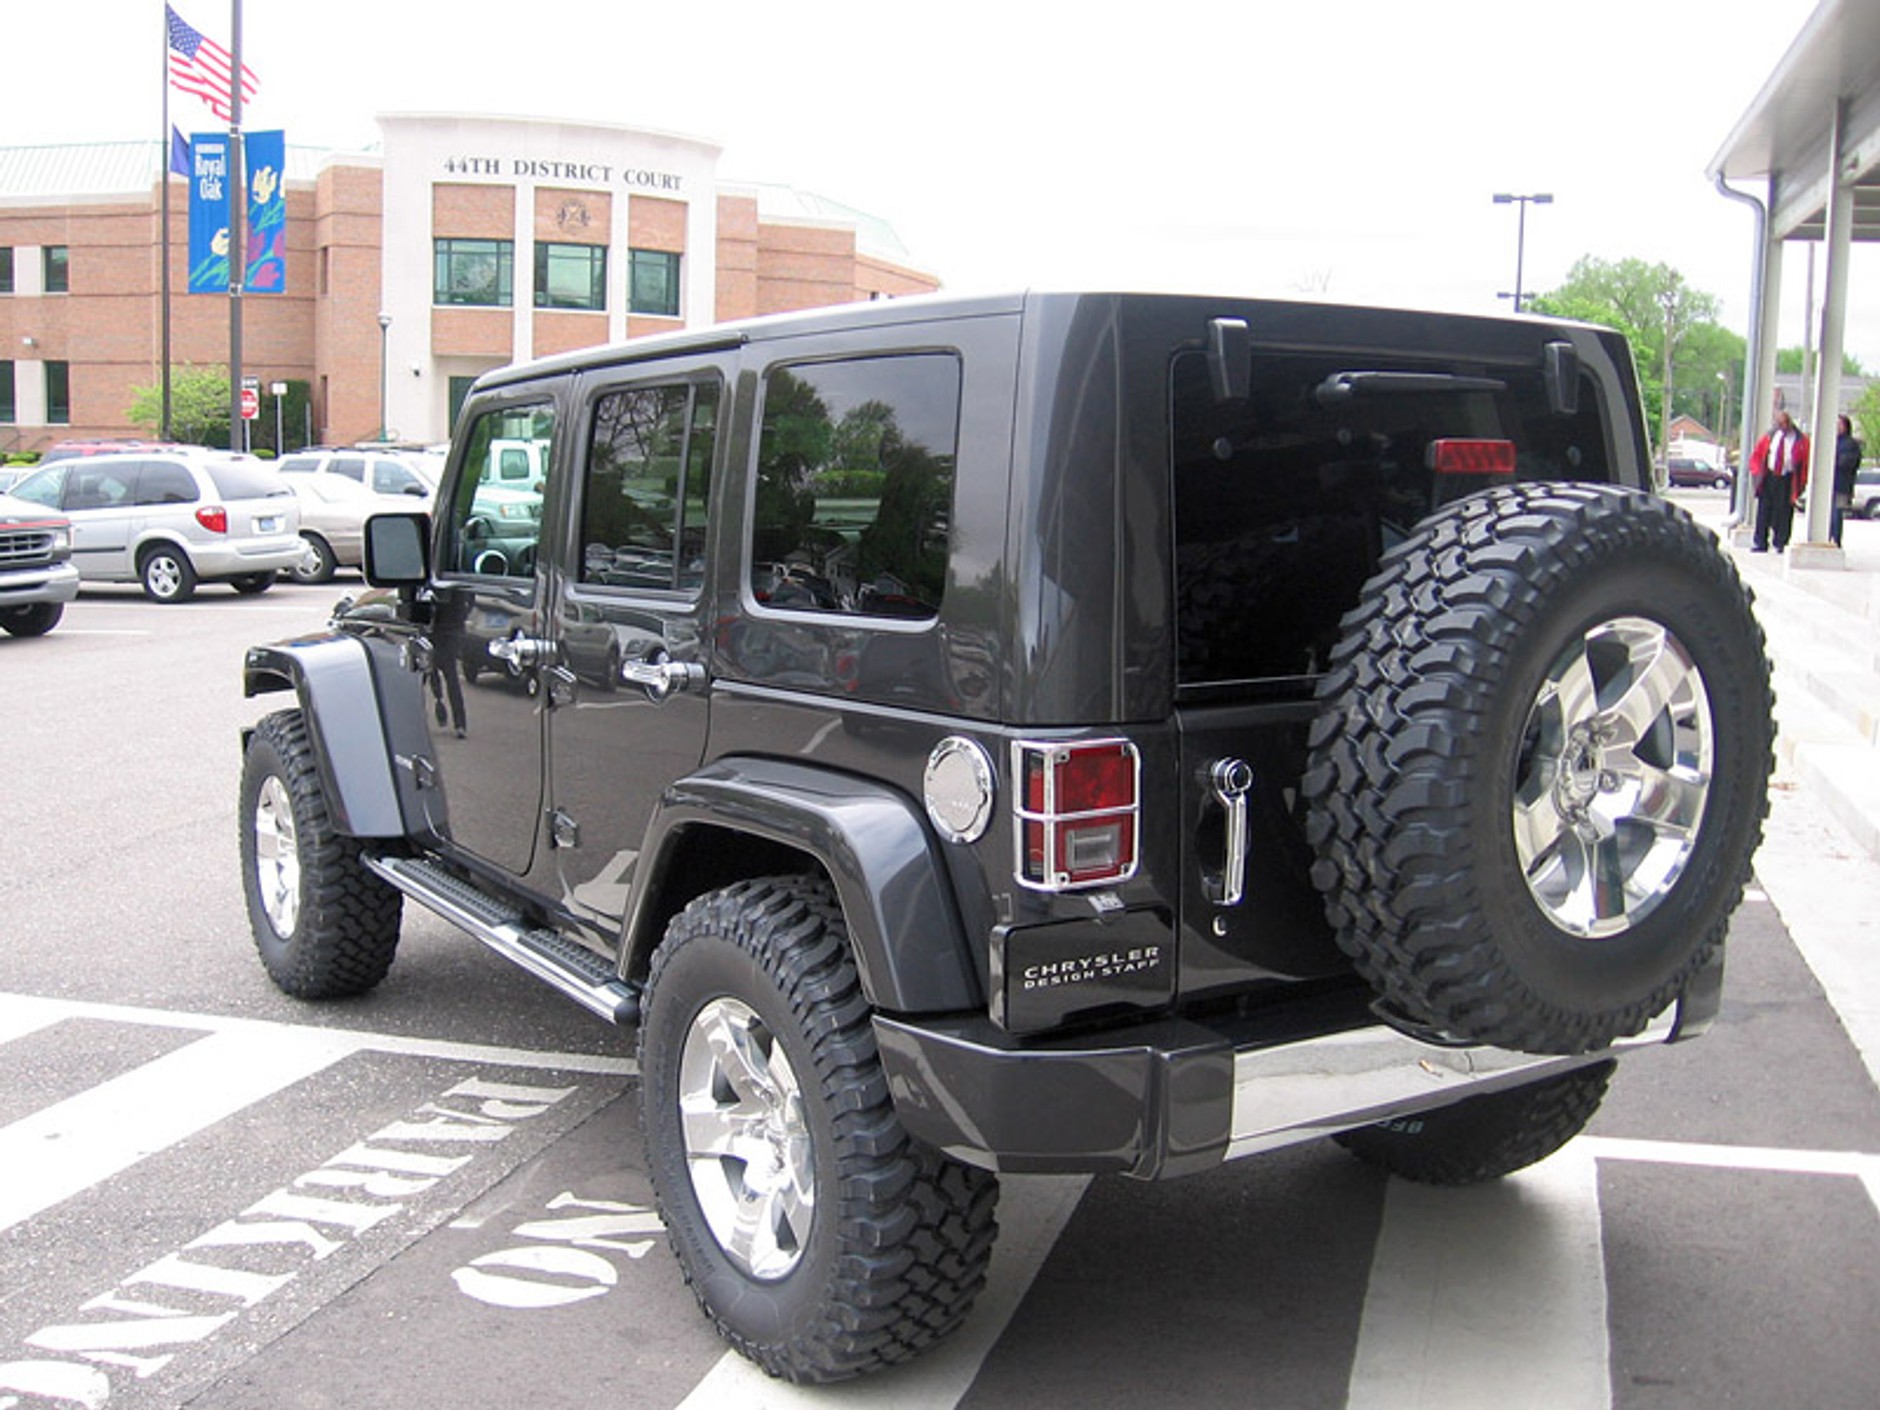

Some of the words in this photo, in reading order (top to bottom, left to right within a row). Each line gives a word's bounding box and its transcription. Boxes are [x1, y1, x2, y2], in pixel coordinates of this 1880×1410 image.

[195, 154, 226, 182] Royal
[443, 156, 500, 174] 44TH
[513, 159, 613, 182] DISTRICT
[623, 168, 683, 191] COURT
[200, 178, 222, 200] Oak
[1023, 946, 1160, 979] CHRYSLER
[1023, 969, 1095, 989] DESIGN
[1101, 958, 1160, 977] STAFF
[450, 1191, 665, 1309] NO
